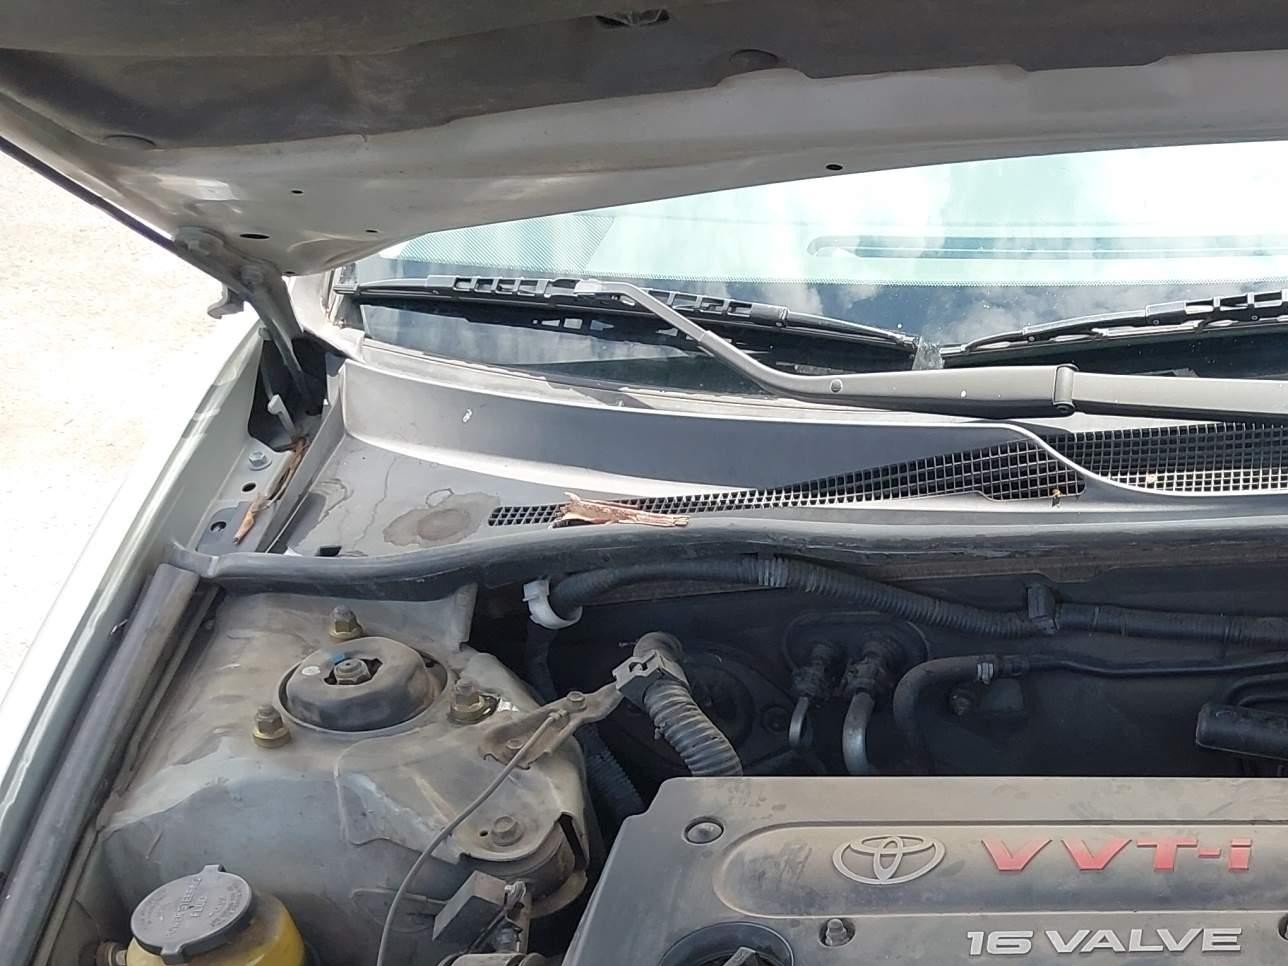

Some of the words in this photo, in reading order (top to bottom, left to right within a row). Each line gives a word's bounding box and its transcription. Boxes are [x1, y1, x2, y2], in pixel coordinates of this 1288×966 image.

[981, 838, 1252, 872] VVT-i
[967, 930, 1034, 956] 16
[1045, 928, 1243, 954] VALVE
